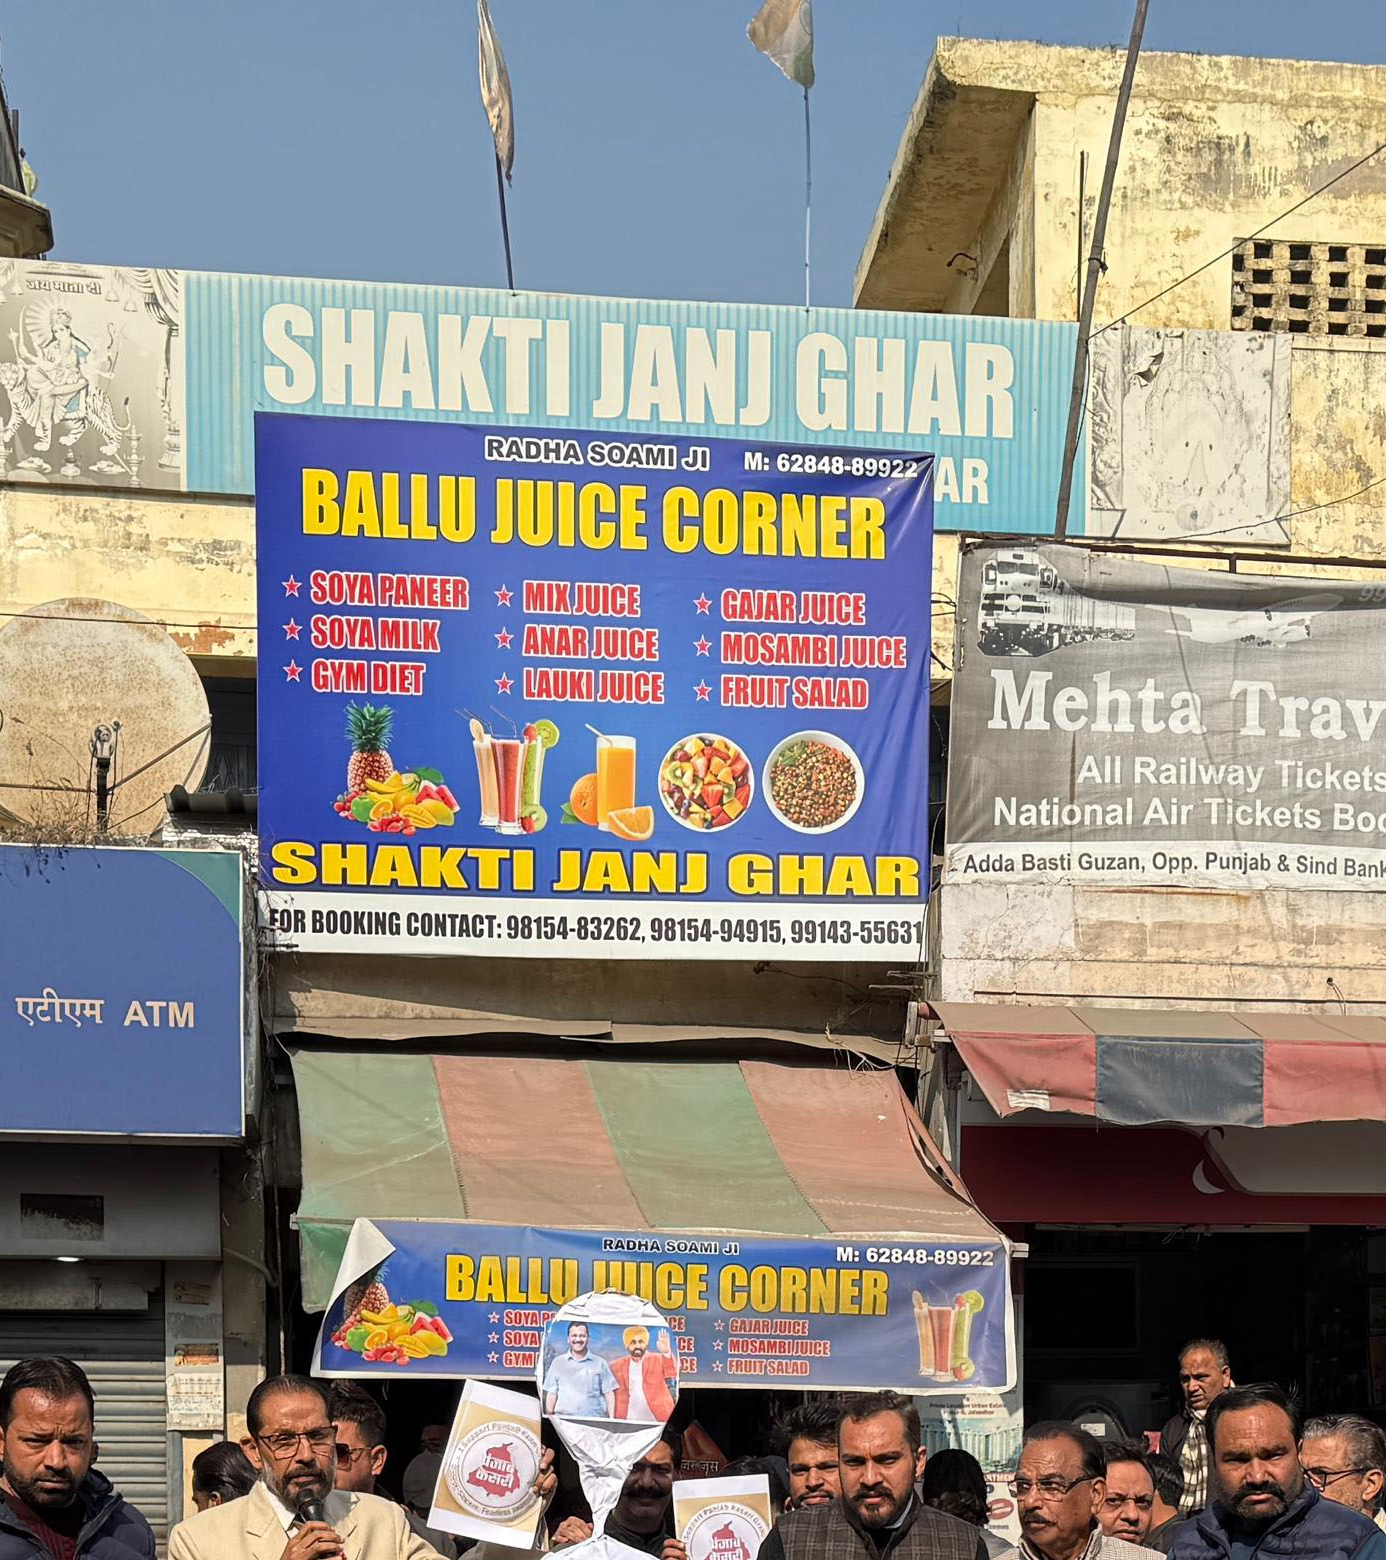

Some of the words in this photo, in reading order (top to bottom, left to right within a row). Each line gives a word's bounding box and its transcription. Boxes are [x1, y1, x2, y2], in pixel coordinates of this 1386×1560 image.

[26, 279, 51, 291] जय
[53, 281, 84, 293] माता
[85, 283, 102, 295] दी
[261, 304, 573, 418] SHAKTI
[592, 320, 773, 428] JANJ
[794, 334, 1013, 439] GHAR
[485, 436, 581, 464] RADHA
[587, 443, 675, 469] SOAMI
[681, 447, 711, 472] JI
[743, 450, 771, 473] M:
[776, 453, 918, 479] 62848-89922
[301, 468, 476, 542] BALLU
[490, 478, 648, 551] JUICE
[663, 486, 887, 561] CORNER
[310, 571, 374, 606] SOYA
[378, 574, 469, 611] PANEER
[522, 579, 569, 615] MIX
[574, 582, 640, 618] JUICE
[721, 589, 795, 624] GAJAR
[800, 592, 866, 626] JUICE
[310, 615, 373, 650] SOYA
[378, 618, 440, 653] MILK
[522, 624, 587, 659] ANAR
[593, 627, 659, 662] JUICE
[721, 632, 836, 668] MOSAMBI
[841, 635, 907, 670] JUICE
[310, 659, 367, 694] GYM
[373, 661, 425, 696] DIET
[522, 667, 593, 702] LAUKI
[595, 670, 665, 704] JUICE
[721, 674, 790, 709] FRUIT
[793, 677, 869, 711] SALAD
[987, 668, 1206, 736] Mehta
[1077, 755, 1121, 786] All
[1133, 757, 1264, 794] Railway
[993, 797, 1132, 827] National
[1142, 798, 1193, 827] Air
[1203, 799, 1322, 831] Tickets
[270, 841, 537, 892] SHAKTI
[552, 850, 708, 896] JANJ
[727, 854, 920, 898] GHAR
[963, 854, 1015, 875] Adda
[1021, 853, 1072, 874] Basti
[1078, 853, 1146, 876] Guzan,
[1152, 852, 1199, 876] Opp.
[1204, 852, 1272, 878] Punjab
[1277, 854, 1291, 874] &
[1296, 856, 1339, 876] Sind
[270, 908, 306, 935] FOR
[311, 909, 402, 939] BOOKING
[406, 911, 503, 941] CONTACT:
[506, 914, 647, 946] 98154-83262,
[650, 917, 786, 948] 98154-94915,
[789, 918, 923, 946] 99143-55631
[15, 988, 104, 1028] एटीएम
[123, 1000, 195, 1029] ATM
[602, 1238, 659, 1253] RADHA
[662, 1239, 720, 1254] SOAMI
[724, 1240, 740, 1255] JI
[836, 1246, 860, 1264] M:
[865, 1246, 995, 1267] 62848-89922
[445, 1253, 579, 1304] BALLU
[718, 1263, 890, 1316] CORNER
[729, 1319, 769, 1335] GAJAR
[772, 1320, 809, 1336] JUICE
[728, 1339, 792, 1355] MOSAMBI
[794, 1340, 830, 1356] JUICE
[728, 1359, 765, 1375] FRUIT
[767, 1360, 809, 1376] SALAD
